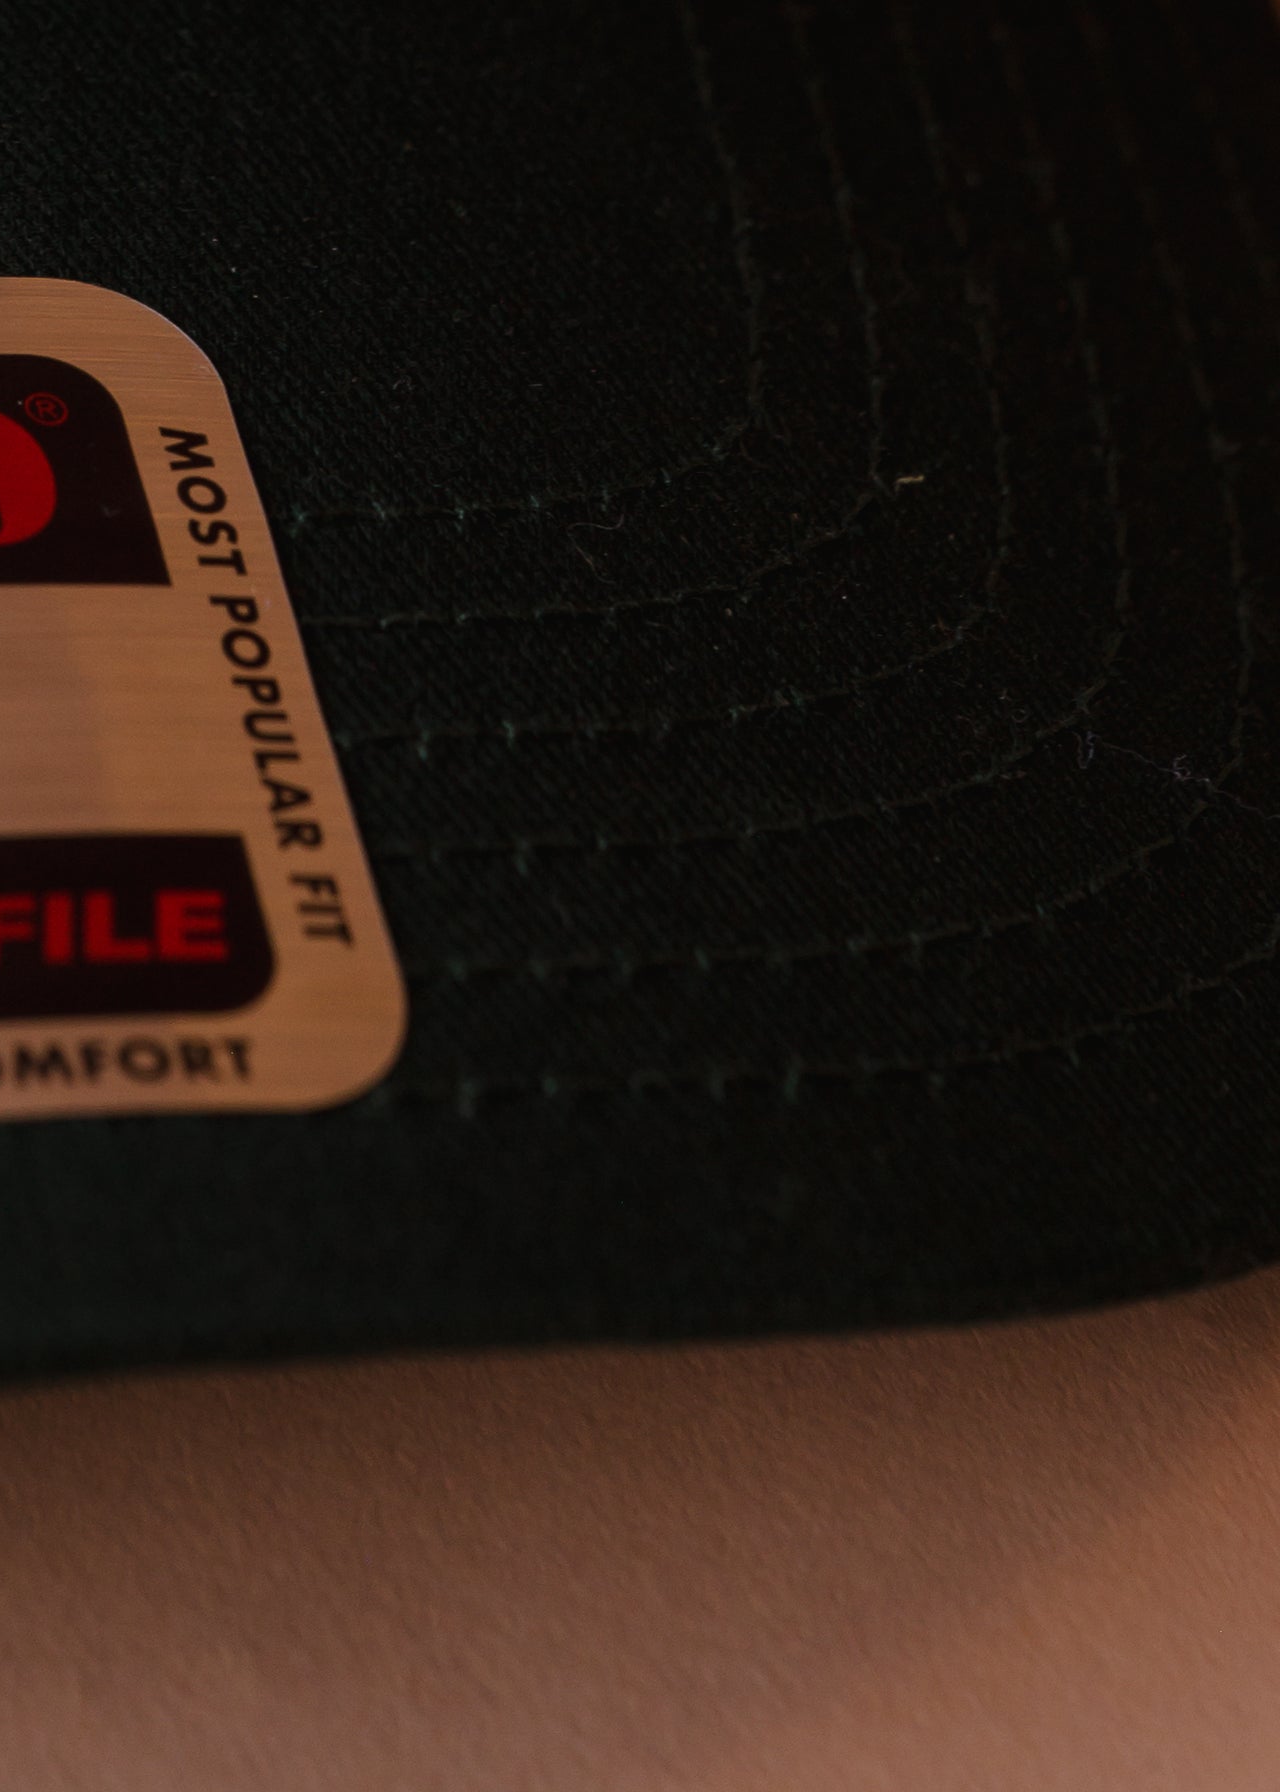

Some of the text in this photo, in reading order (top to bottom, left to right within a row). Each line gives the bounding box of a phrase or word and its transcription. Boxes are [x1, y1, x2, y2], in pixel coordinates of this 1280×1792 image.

[157, 426, 352, 950] MOST POPULAR FIT
